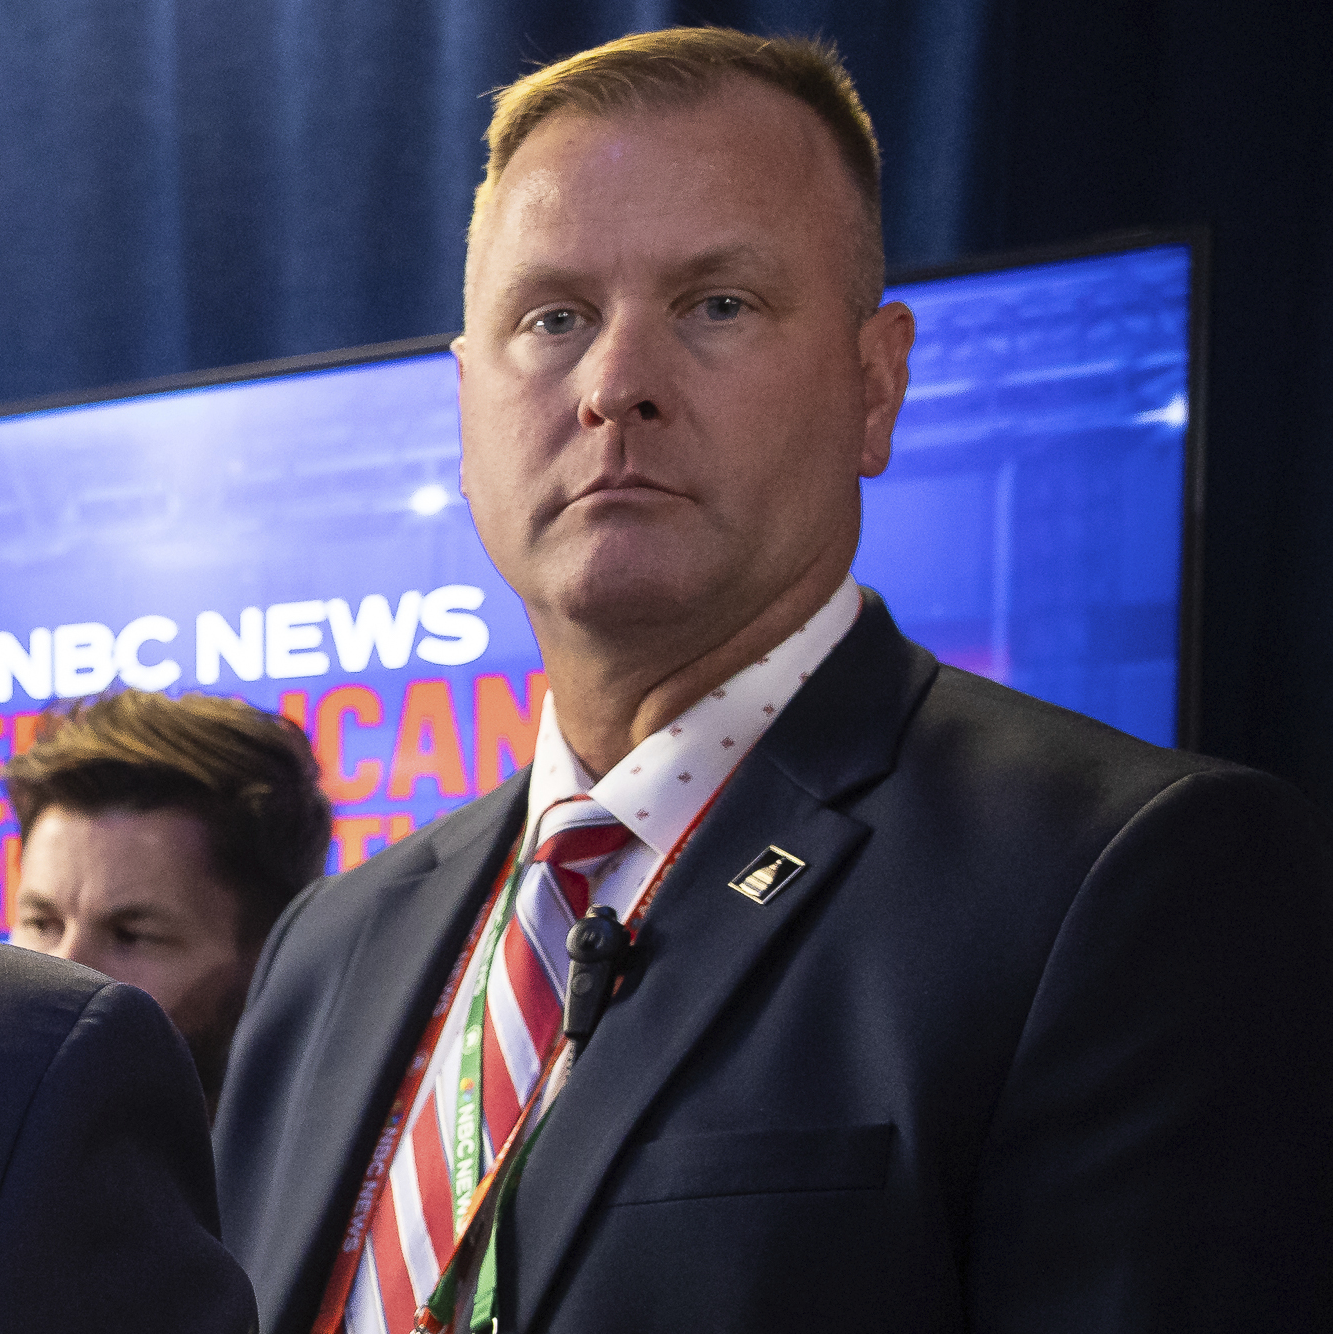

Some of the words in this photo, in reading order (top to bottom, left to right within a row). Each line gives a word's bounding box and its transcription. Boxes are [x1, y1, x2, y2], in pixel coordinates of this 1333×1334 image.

[196, 585, 490, 685] NEWS
[366, 1127, 398, 1177] NBC
[457, 1103, 475, 1159] NBC
[343, 1180, 378, 1252] NEWS
